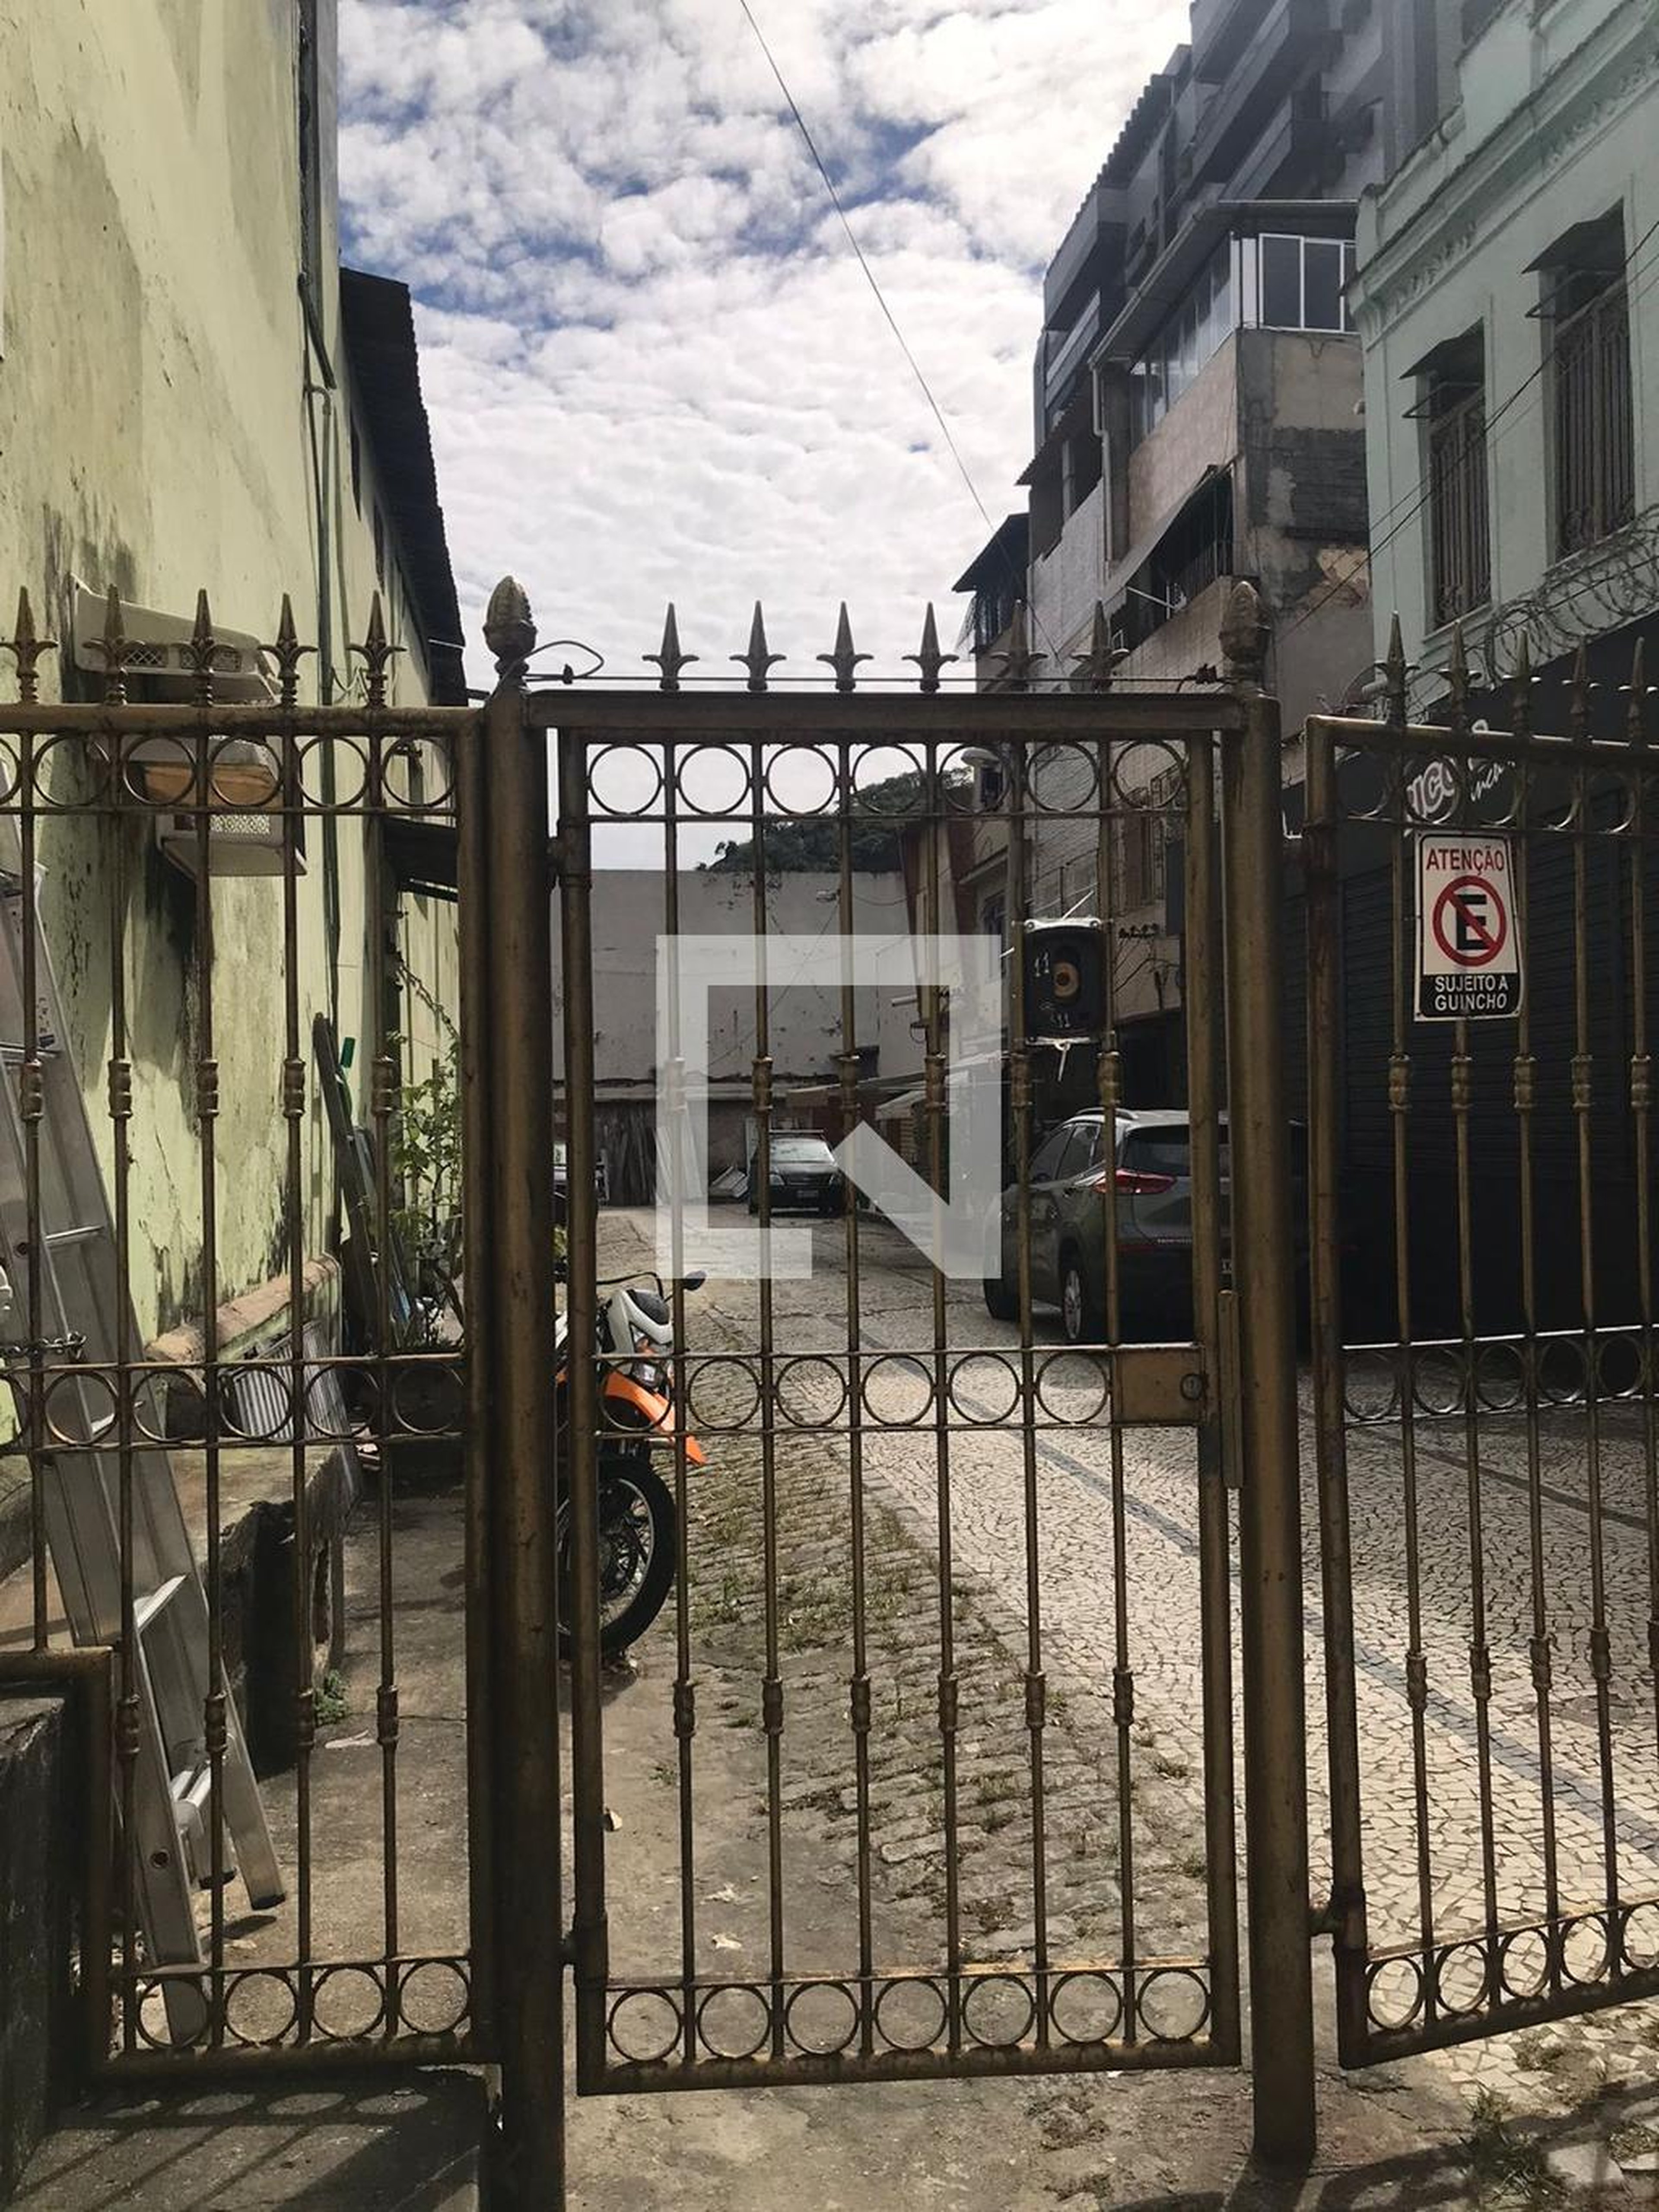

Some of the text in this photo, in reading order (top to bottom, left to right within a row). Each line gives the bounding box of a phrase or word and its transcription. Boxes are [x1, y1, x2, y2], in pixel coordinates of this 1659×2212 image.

[1426, 845, 1504, 875] ATENÇÃO
[1434, 975, 1509, 992] SUJEITO A
[1434, 993, 1507, 1011] GUINCHO
